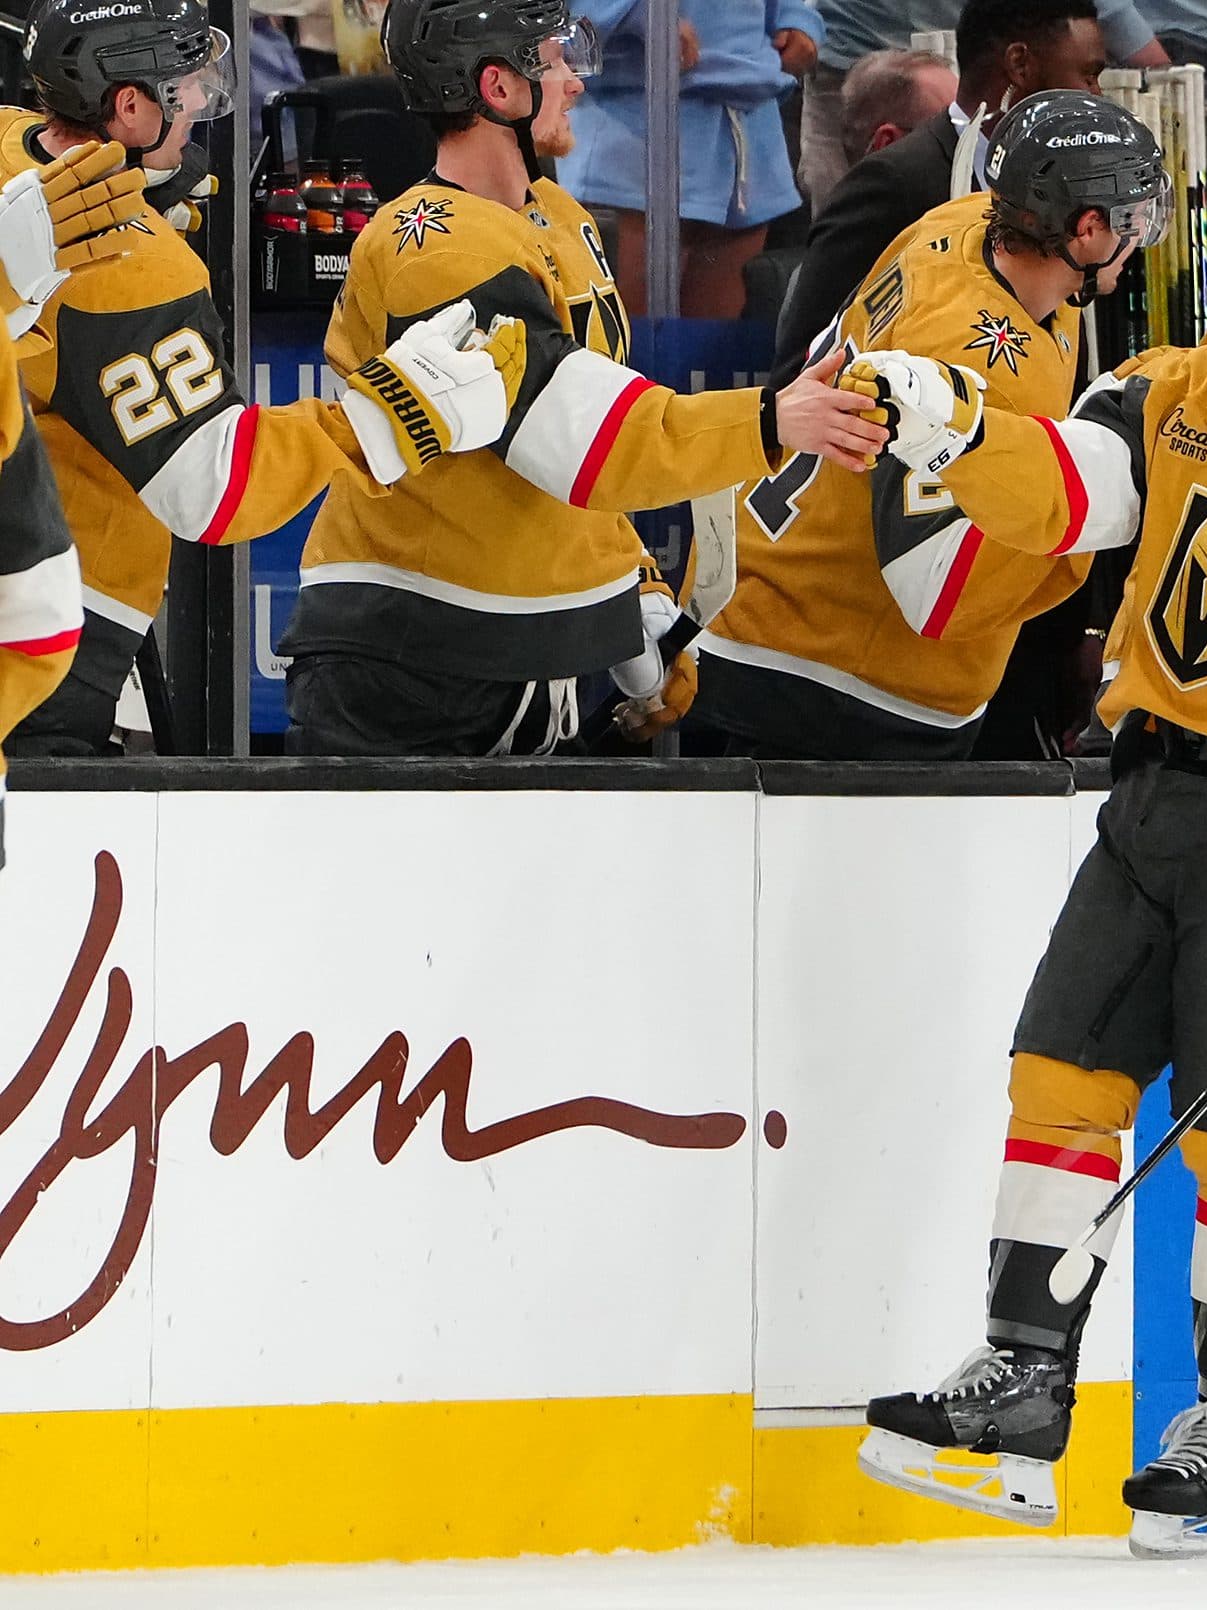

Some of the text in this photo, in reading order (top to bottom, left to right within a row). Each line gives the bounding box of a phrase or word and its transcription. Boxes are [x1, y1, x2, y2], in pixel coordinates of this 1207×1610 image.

[70, 3, 143, 24] CreditOne
[99, 327, 225, 447] 22
[1169, 437, 1207, 462] SPORTS
